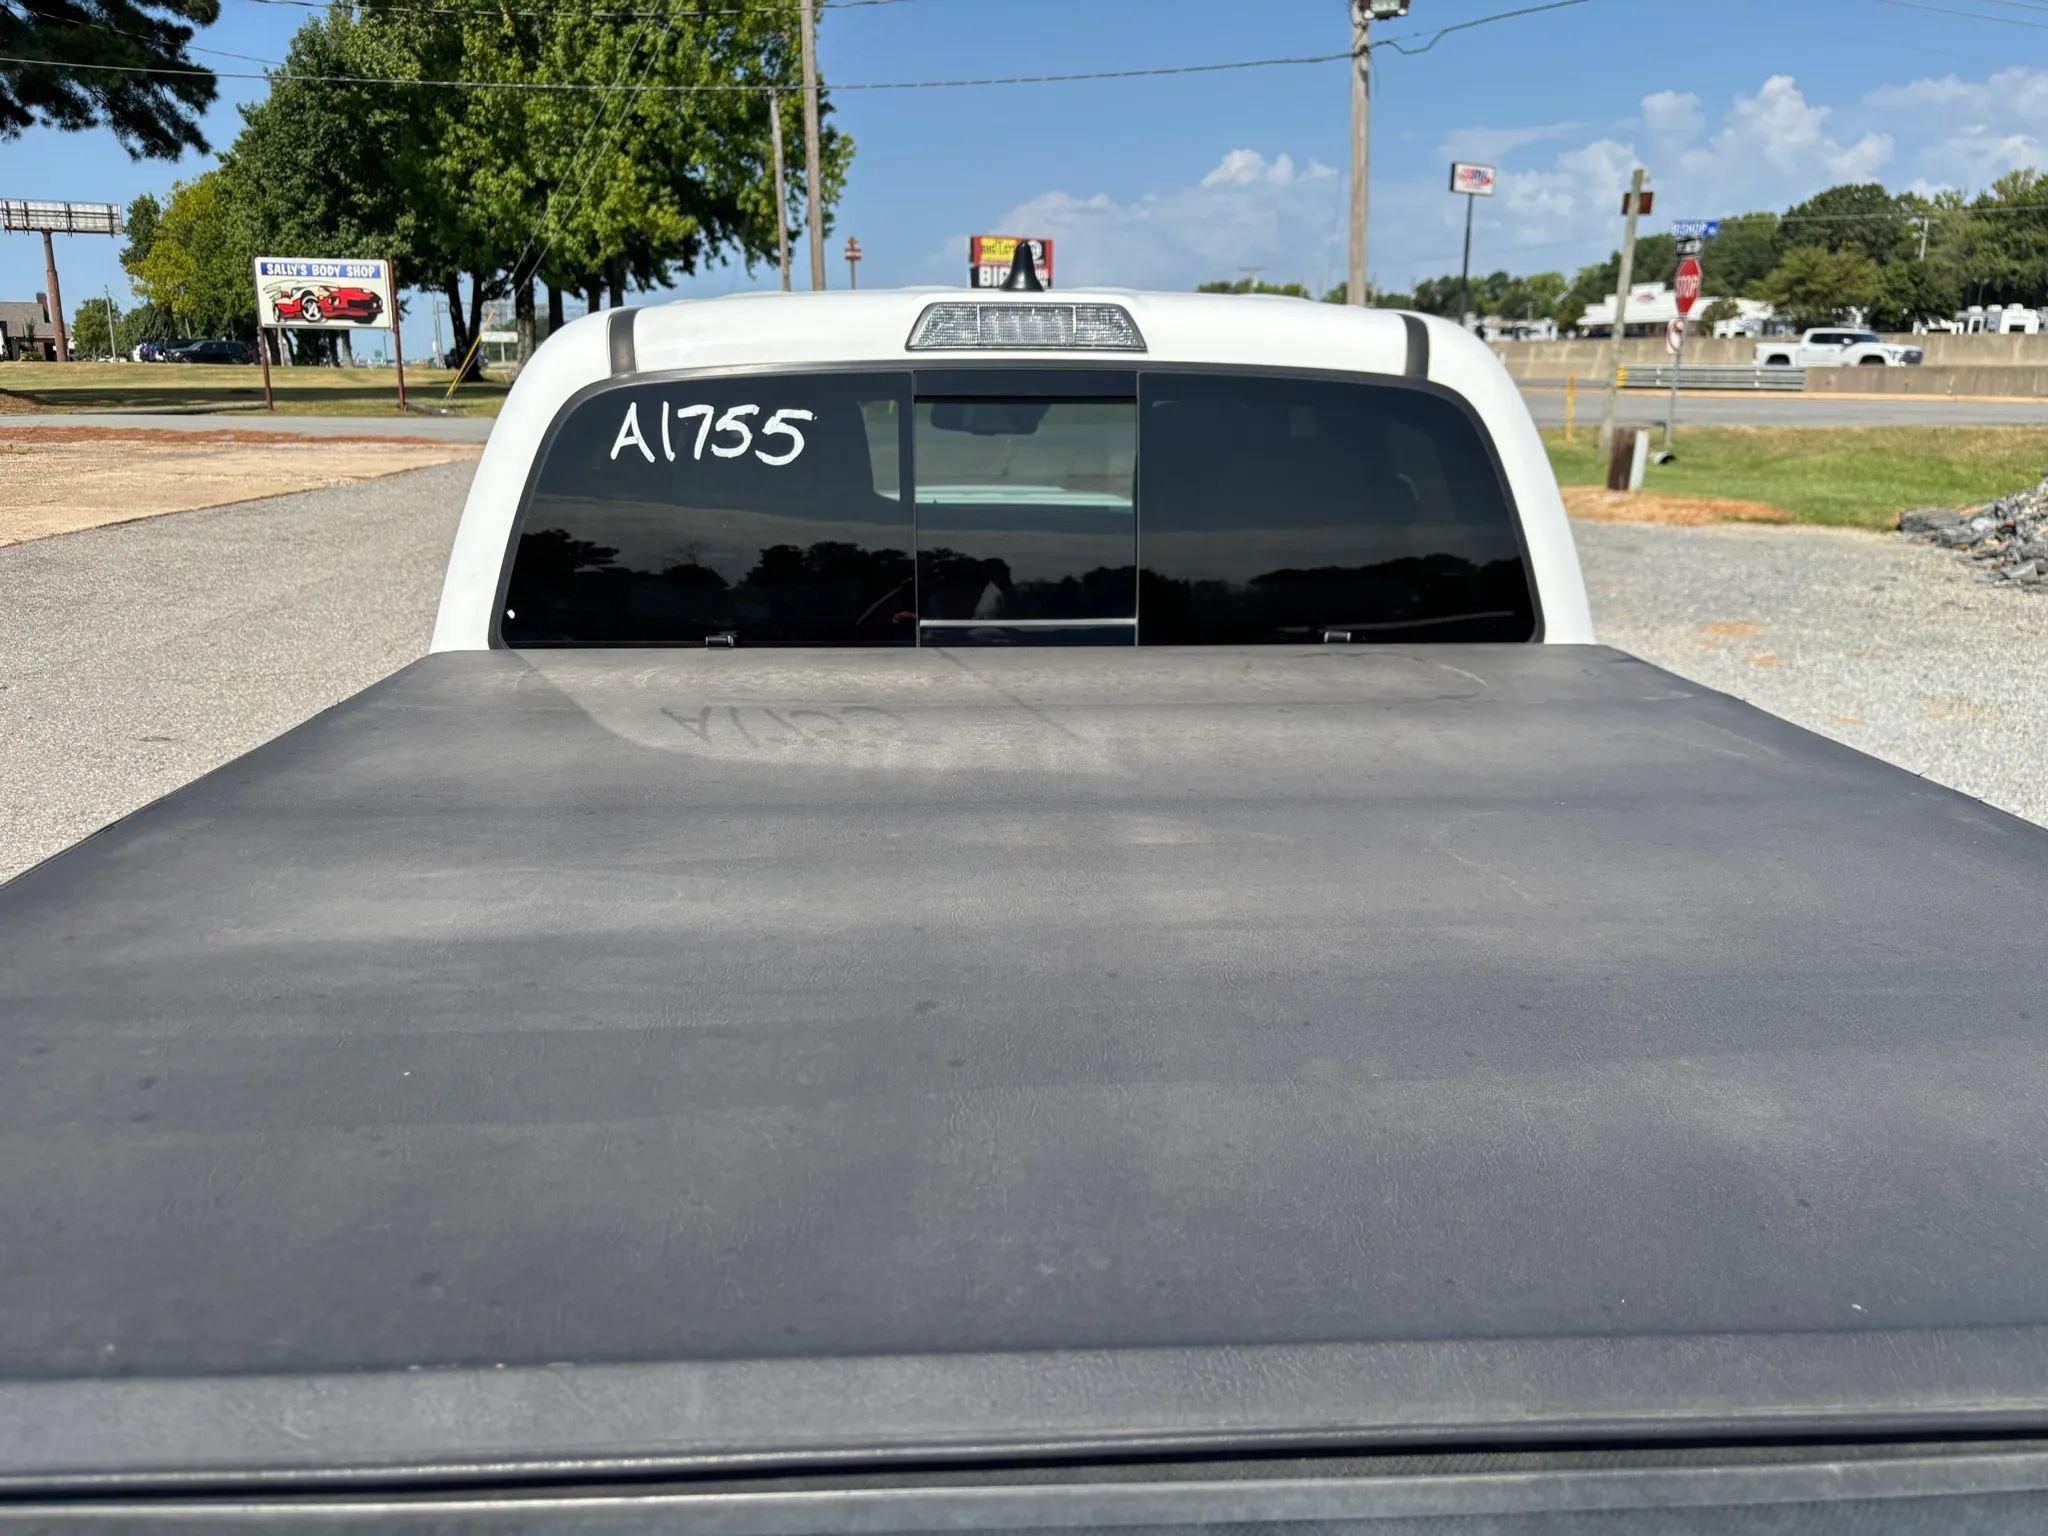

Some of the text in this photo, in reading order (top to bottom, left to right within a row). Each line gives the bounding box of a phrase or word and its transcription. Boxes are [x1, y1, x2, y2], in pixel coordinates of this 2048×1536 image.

[266, 262, 375, 277] SALLY'S BODY SHOP
[1676, 276, 1699, 298] STOP
[610, 401, 816, 466] A1755
